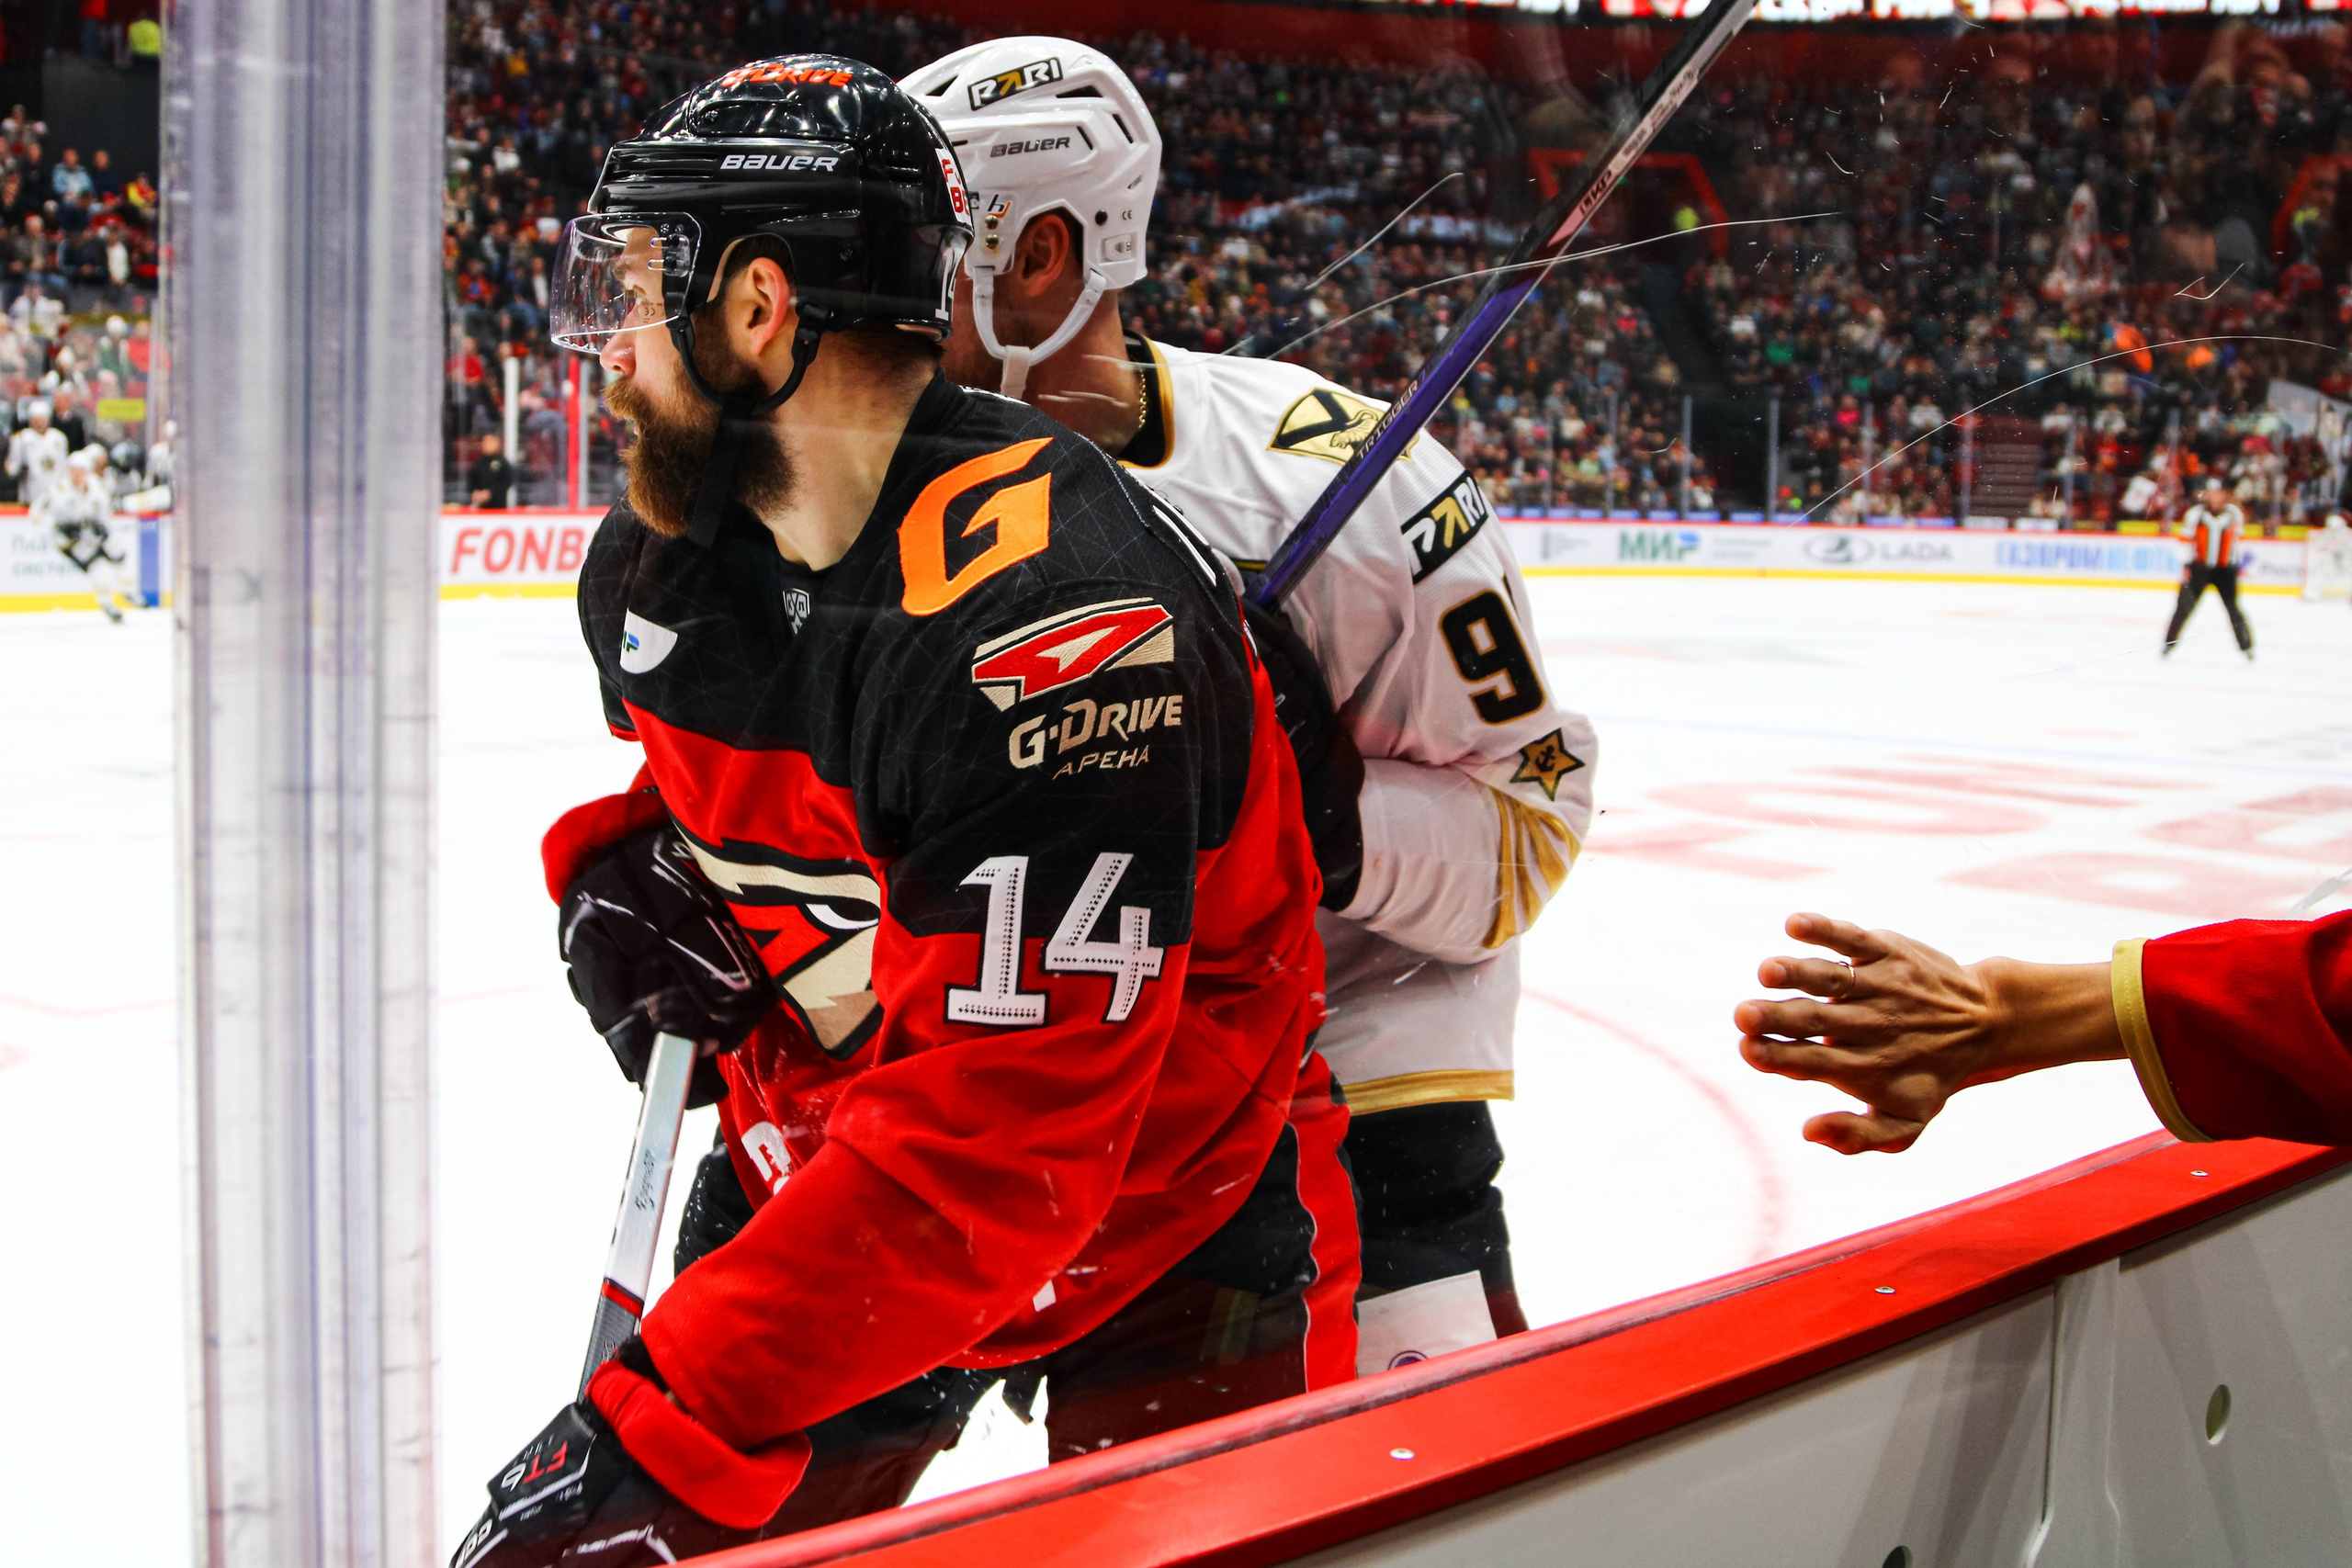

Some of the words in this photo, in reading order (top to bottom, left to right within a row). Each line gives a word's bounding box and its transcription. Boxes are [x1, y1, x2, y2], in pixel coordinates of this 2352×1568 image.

[720, 154, 840, 172] BAUER
[989, 137, 1070, 158] BAUER
[1357, 380, 1419, 459] TRIGGER
[452, 527, 584, 574] FONB
[1439, 588, 1548, 726] 9
[1052, 744, 1149, 781] АРЕНА
[947, 852, 1164, 1026] 14
